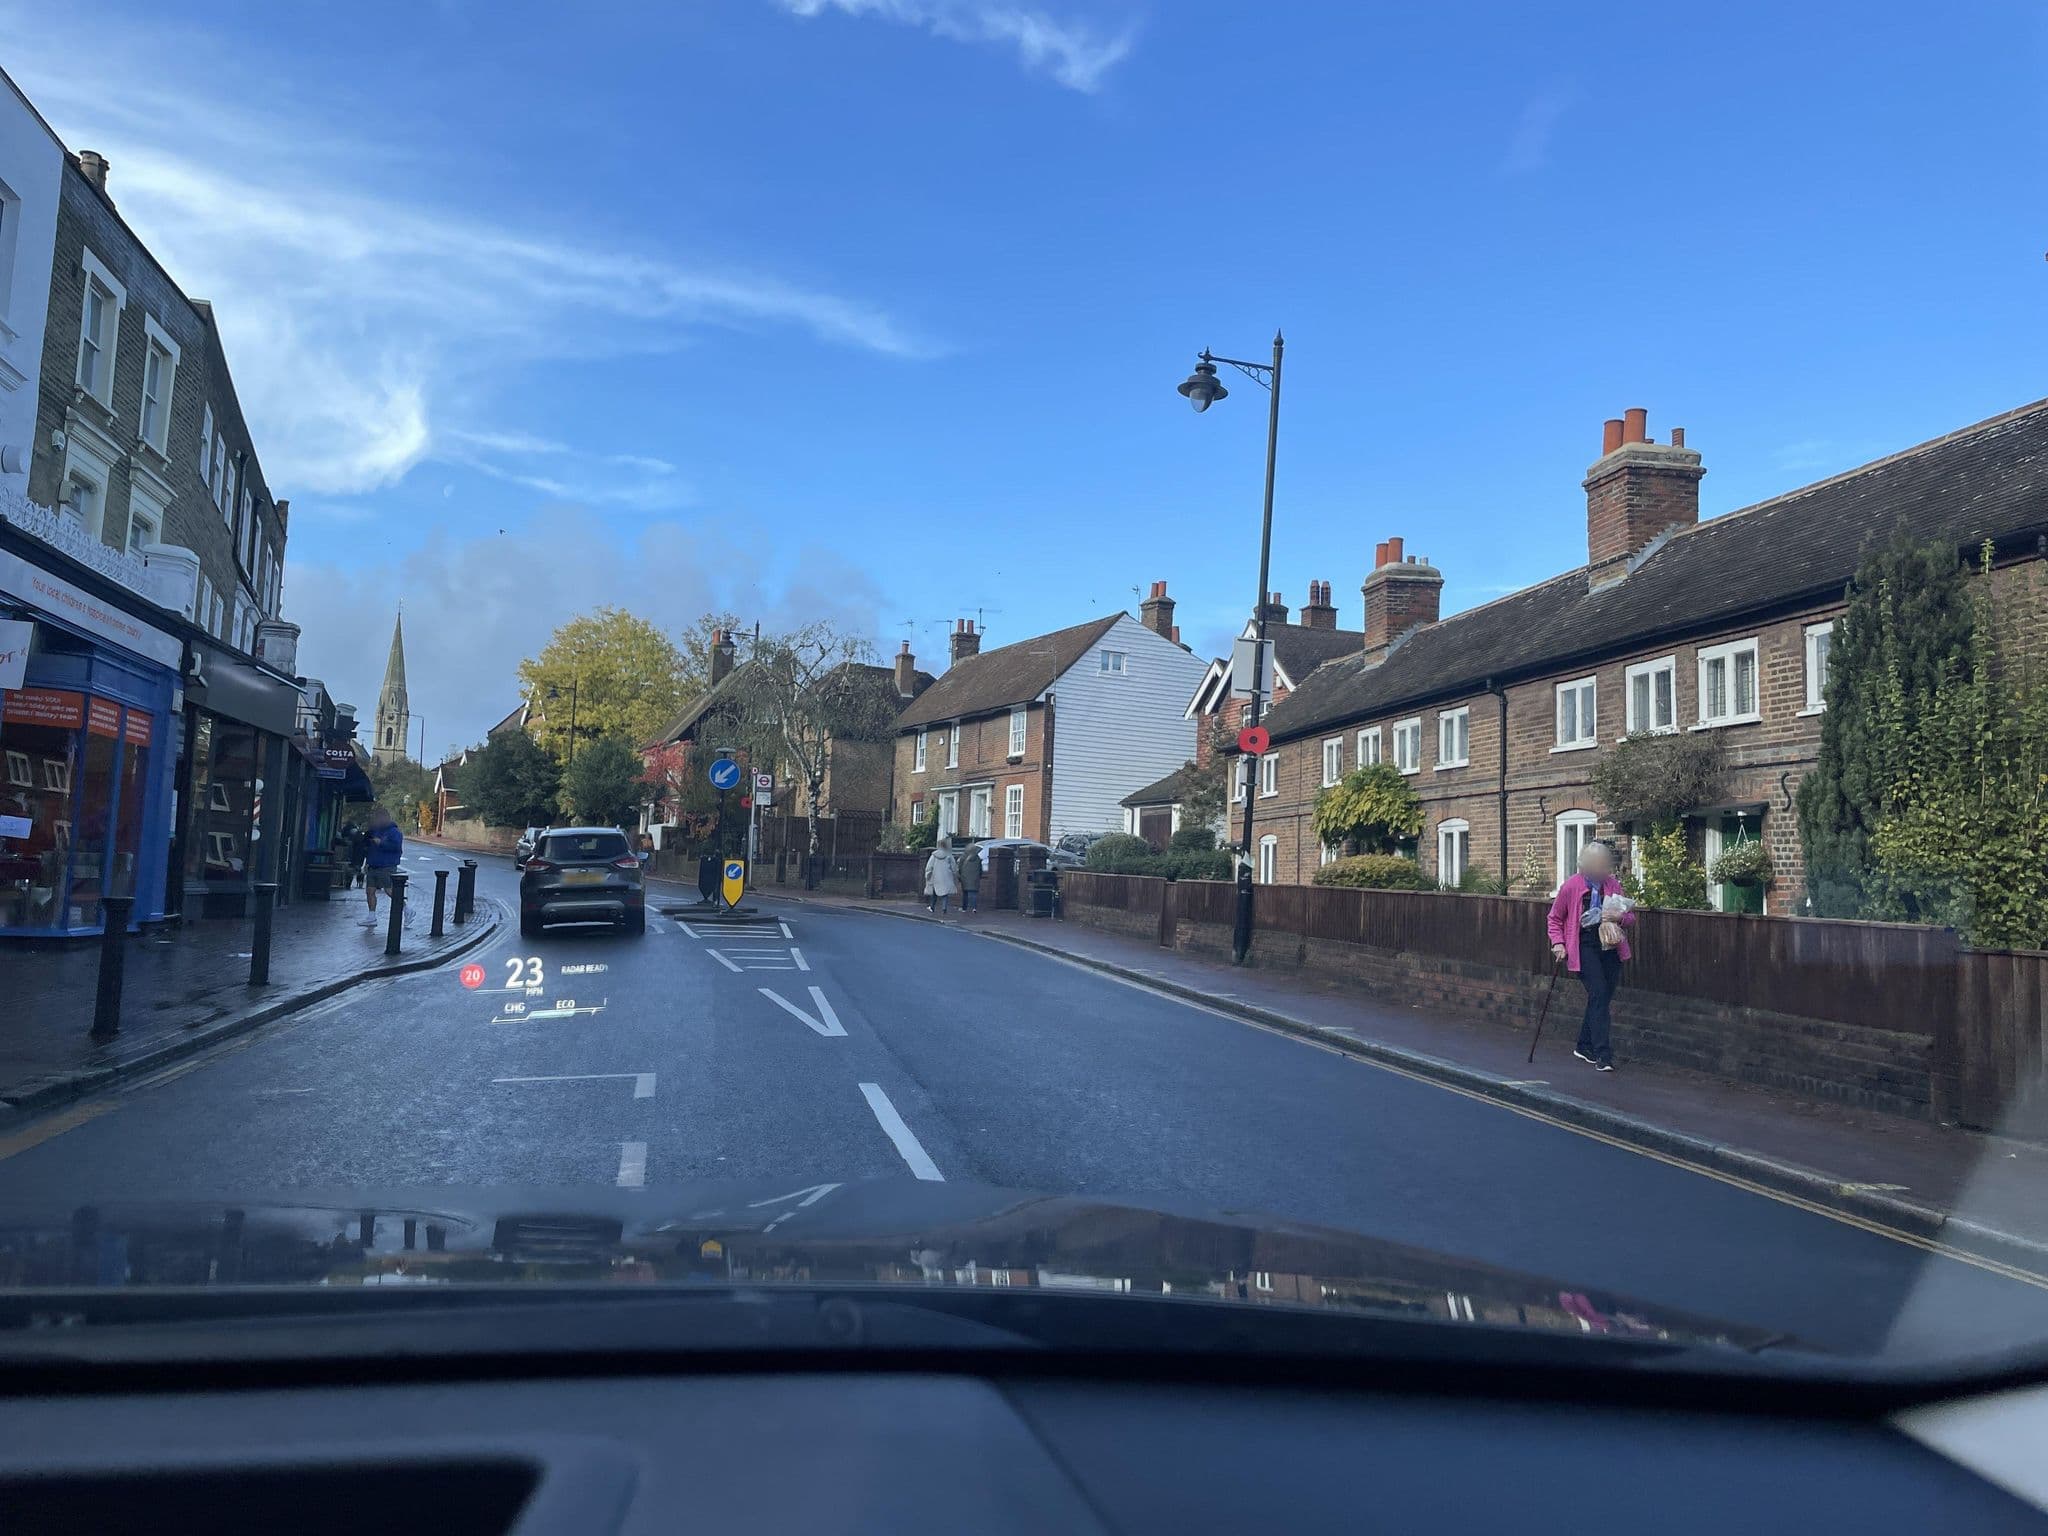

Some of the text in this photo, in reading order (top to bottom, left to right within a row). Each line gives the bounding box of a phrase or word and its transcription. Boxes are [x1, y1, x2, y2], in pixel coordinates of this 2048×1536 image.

[325, 749, 354, 757] COSTA
[465, 969, 480, 981] 20
[504, 956, 545, 989] 23
[561, 964, 585, 975] RADAR
[504, 1002, 526, 1014] CHG
[556, 1000, 576, 1010] ECO
